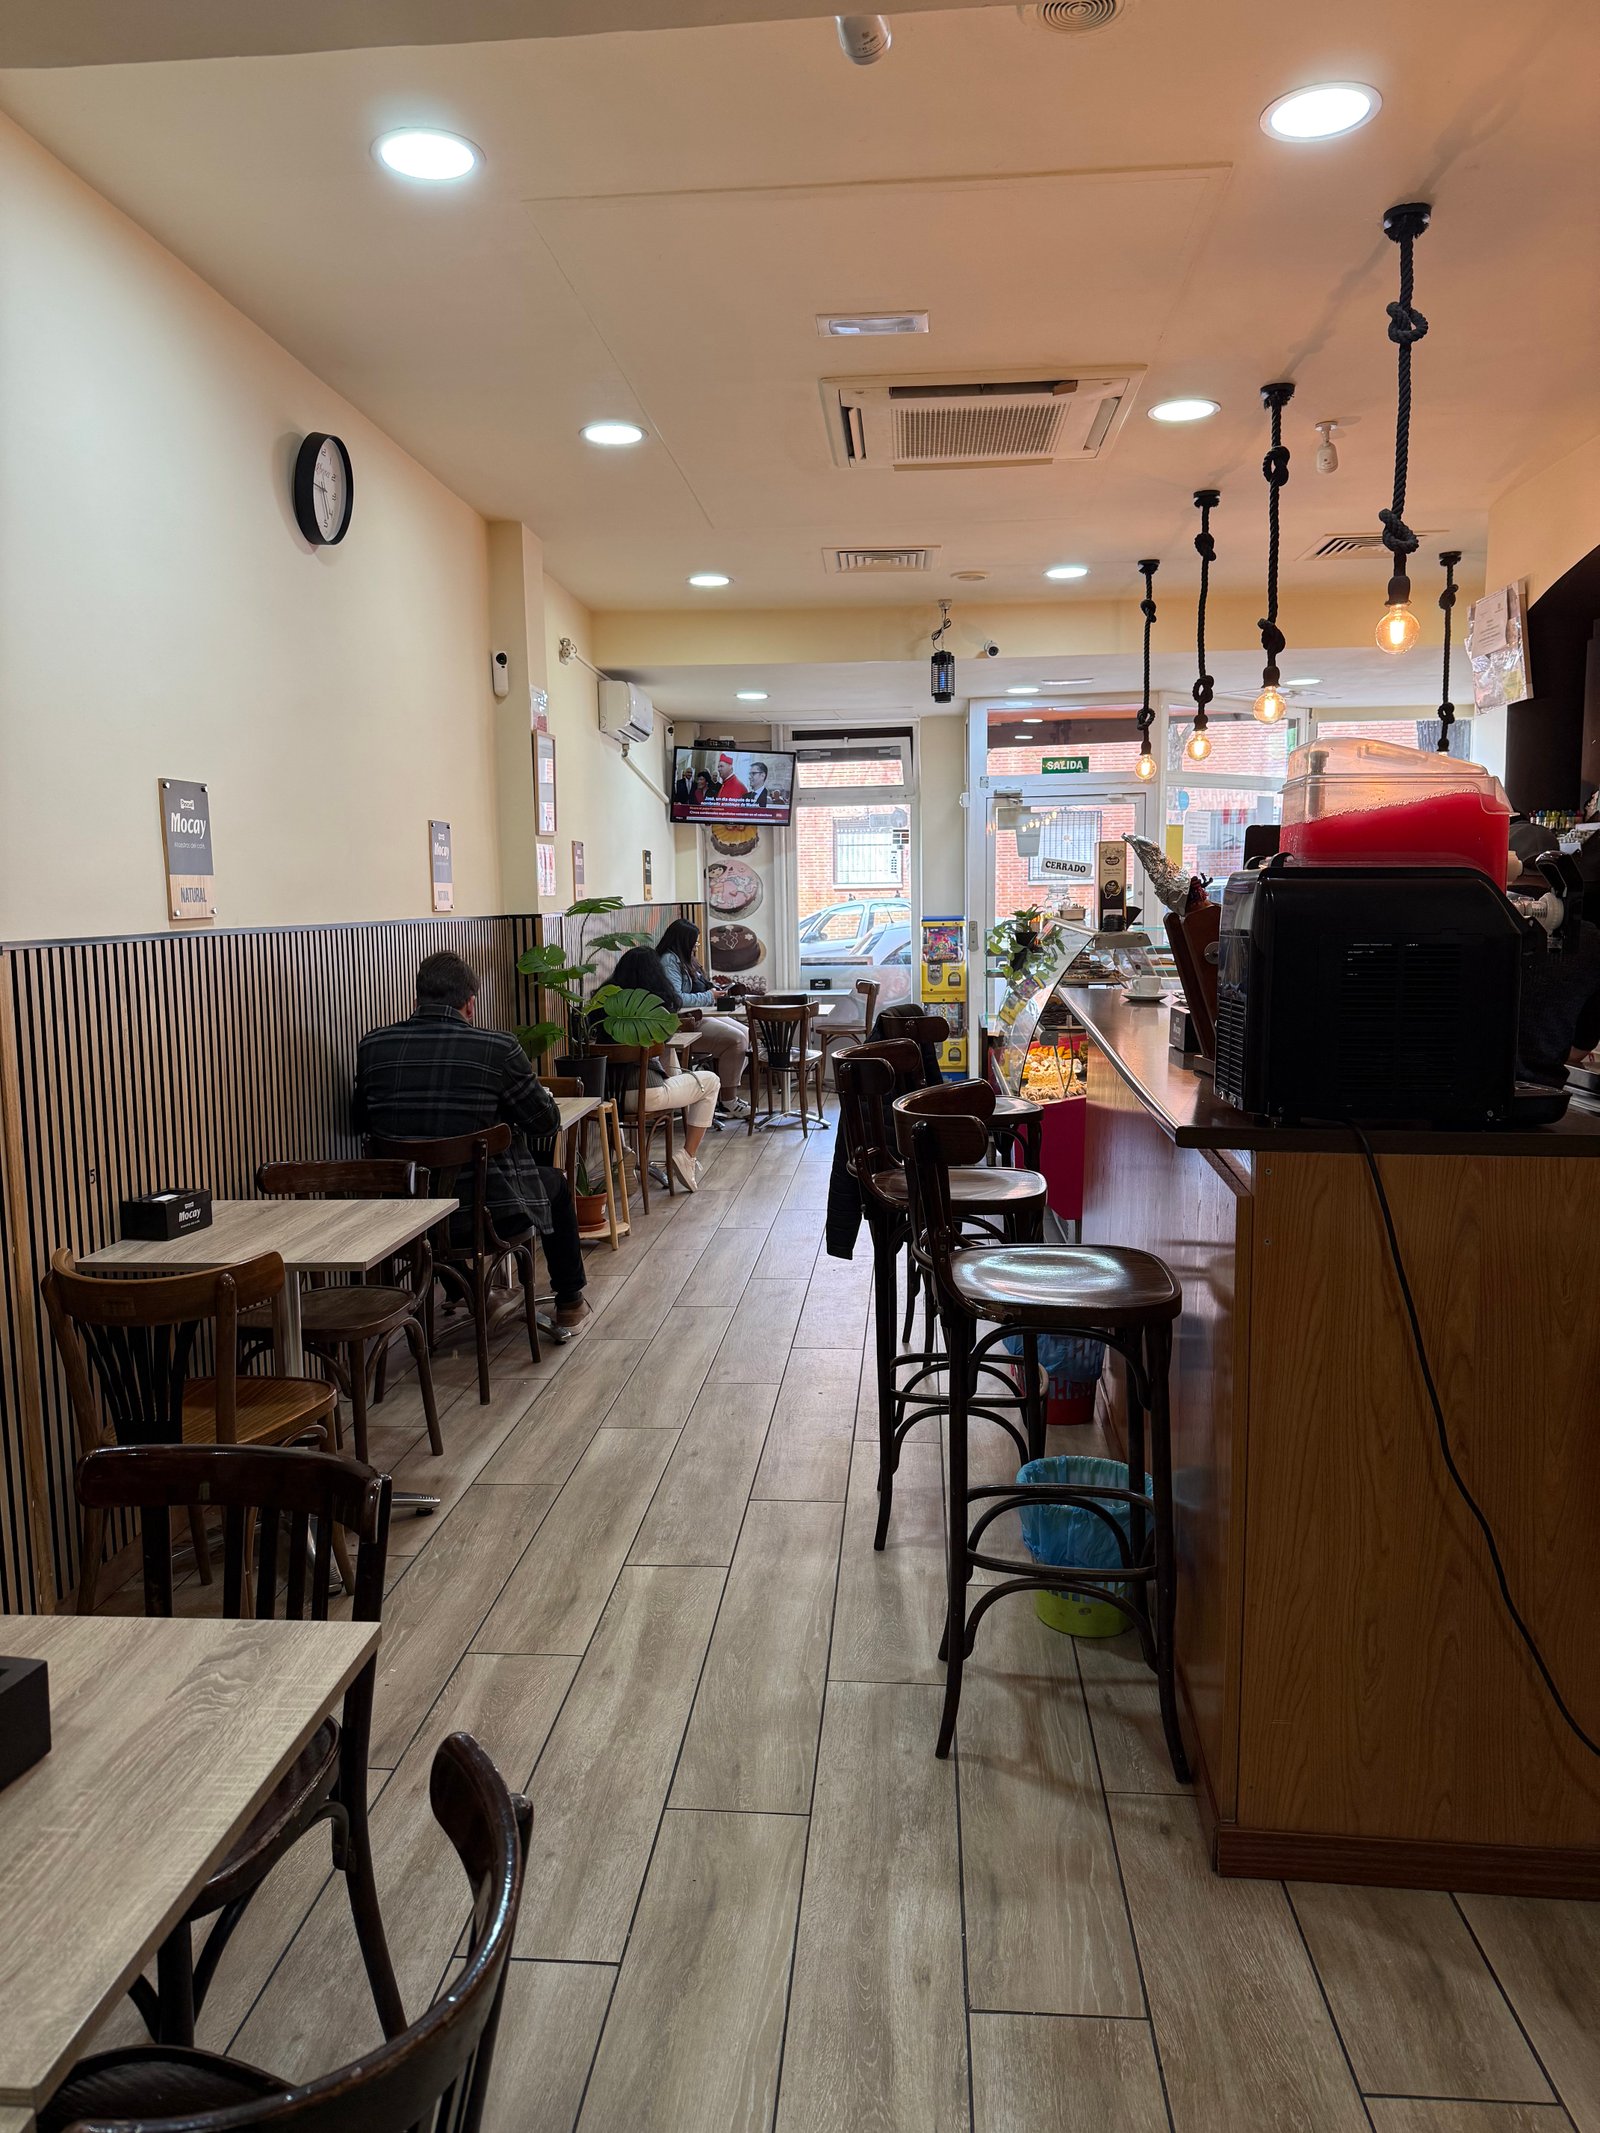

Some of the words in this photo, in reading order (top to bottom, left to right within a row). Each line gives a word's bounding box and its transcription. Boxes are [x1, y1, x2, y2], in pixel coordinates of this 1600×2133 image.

[1047, 760, 1083, 770] SALIDA
[171, 812, 206, 840] Mocay
[1045, 861, 1086, 873] CERRADO
[180, 887, 207, 903] NATURAL
[178, 1208, 201, 1223] Mocay
